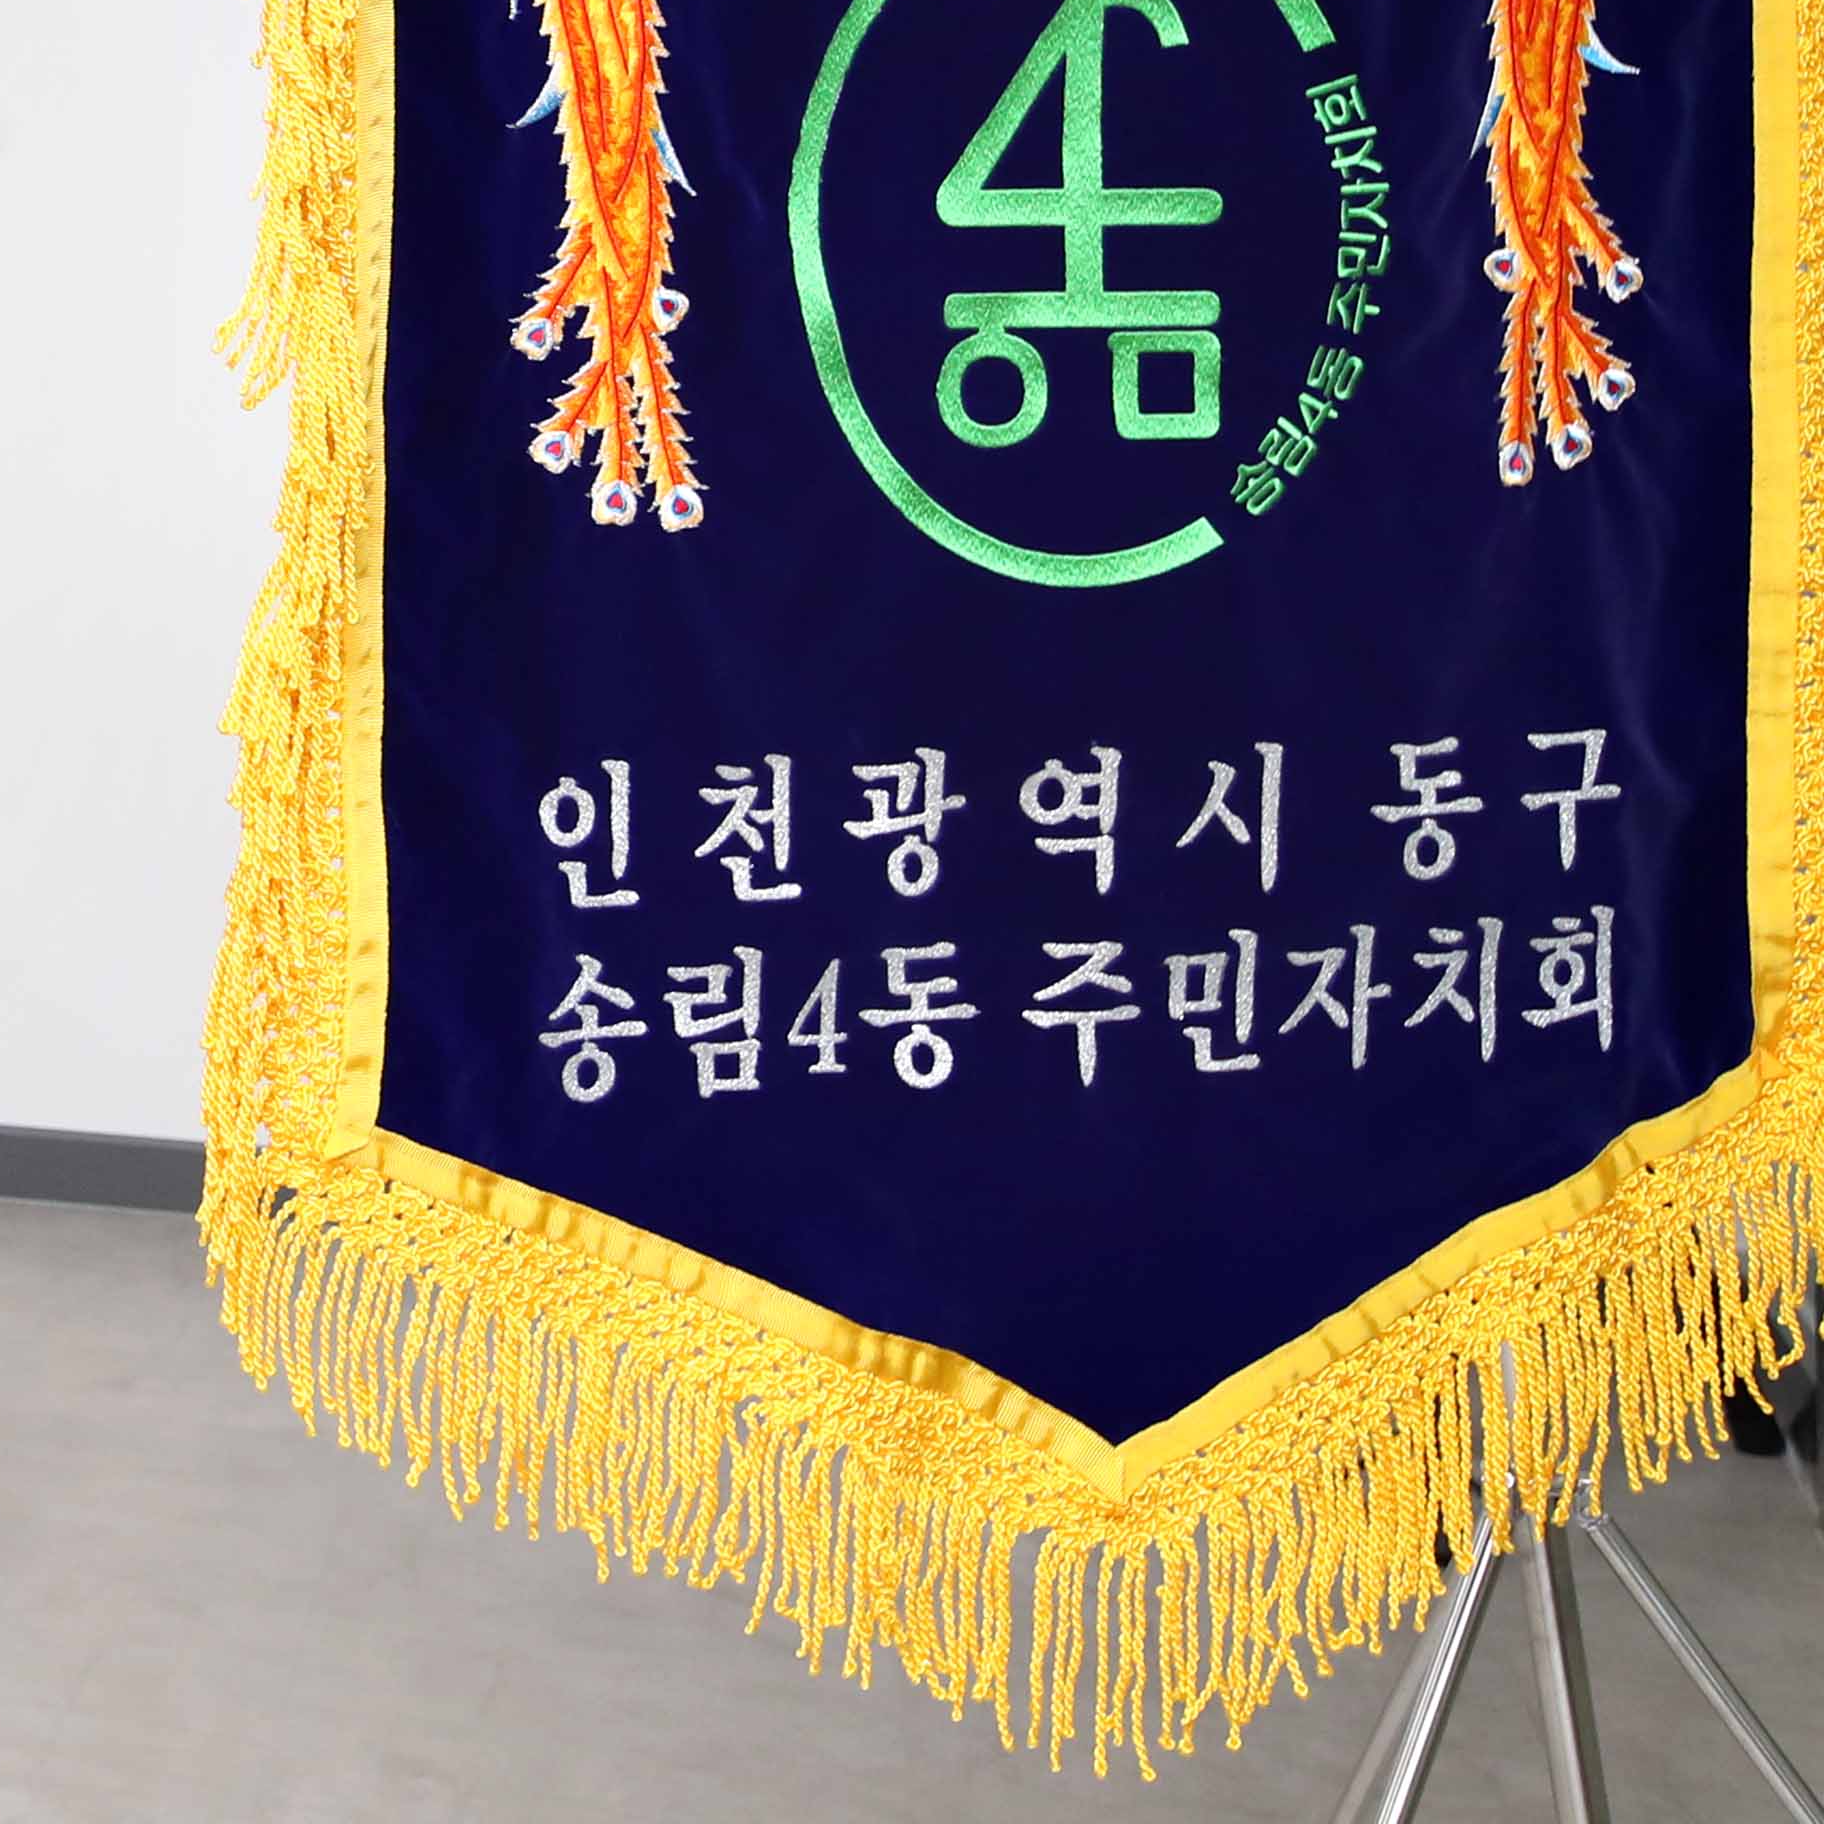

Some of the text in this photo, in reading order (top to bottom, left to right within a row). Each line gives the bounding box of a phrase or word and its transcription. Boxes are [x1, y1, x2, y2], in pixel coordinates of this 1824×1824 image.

[1231, 74, 1390, 516] 송림4동 주민자치회
[538, 729, 1622, 909] 인천광역시 동구
[538, 905, 1615, 1103] 송림4동 주민자치회
